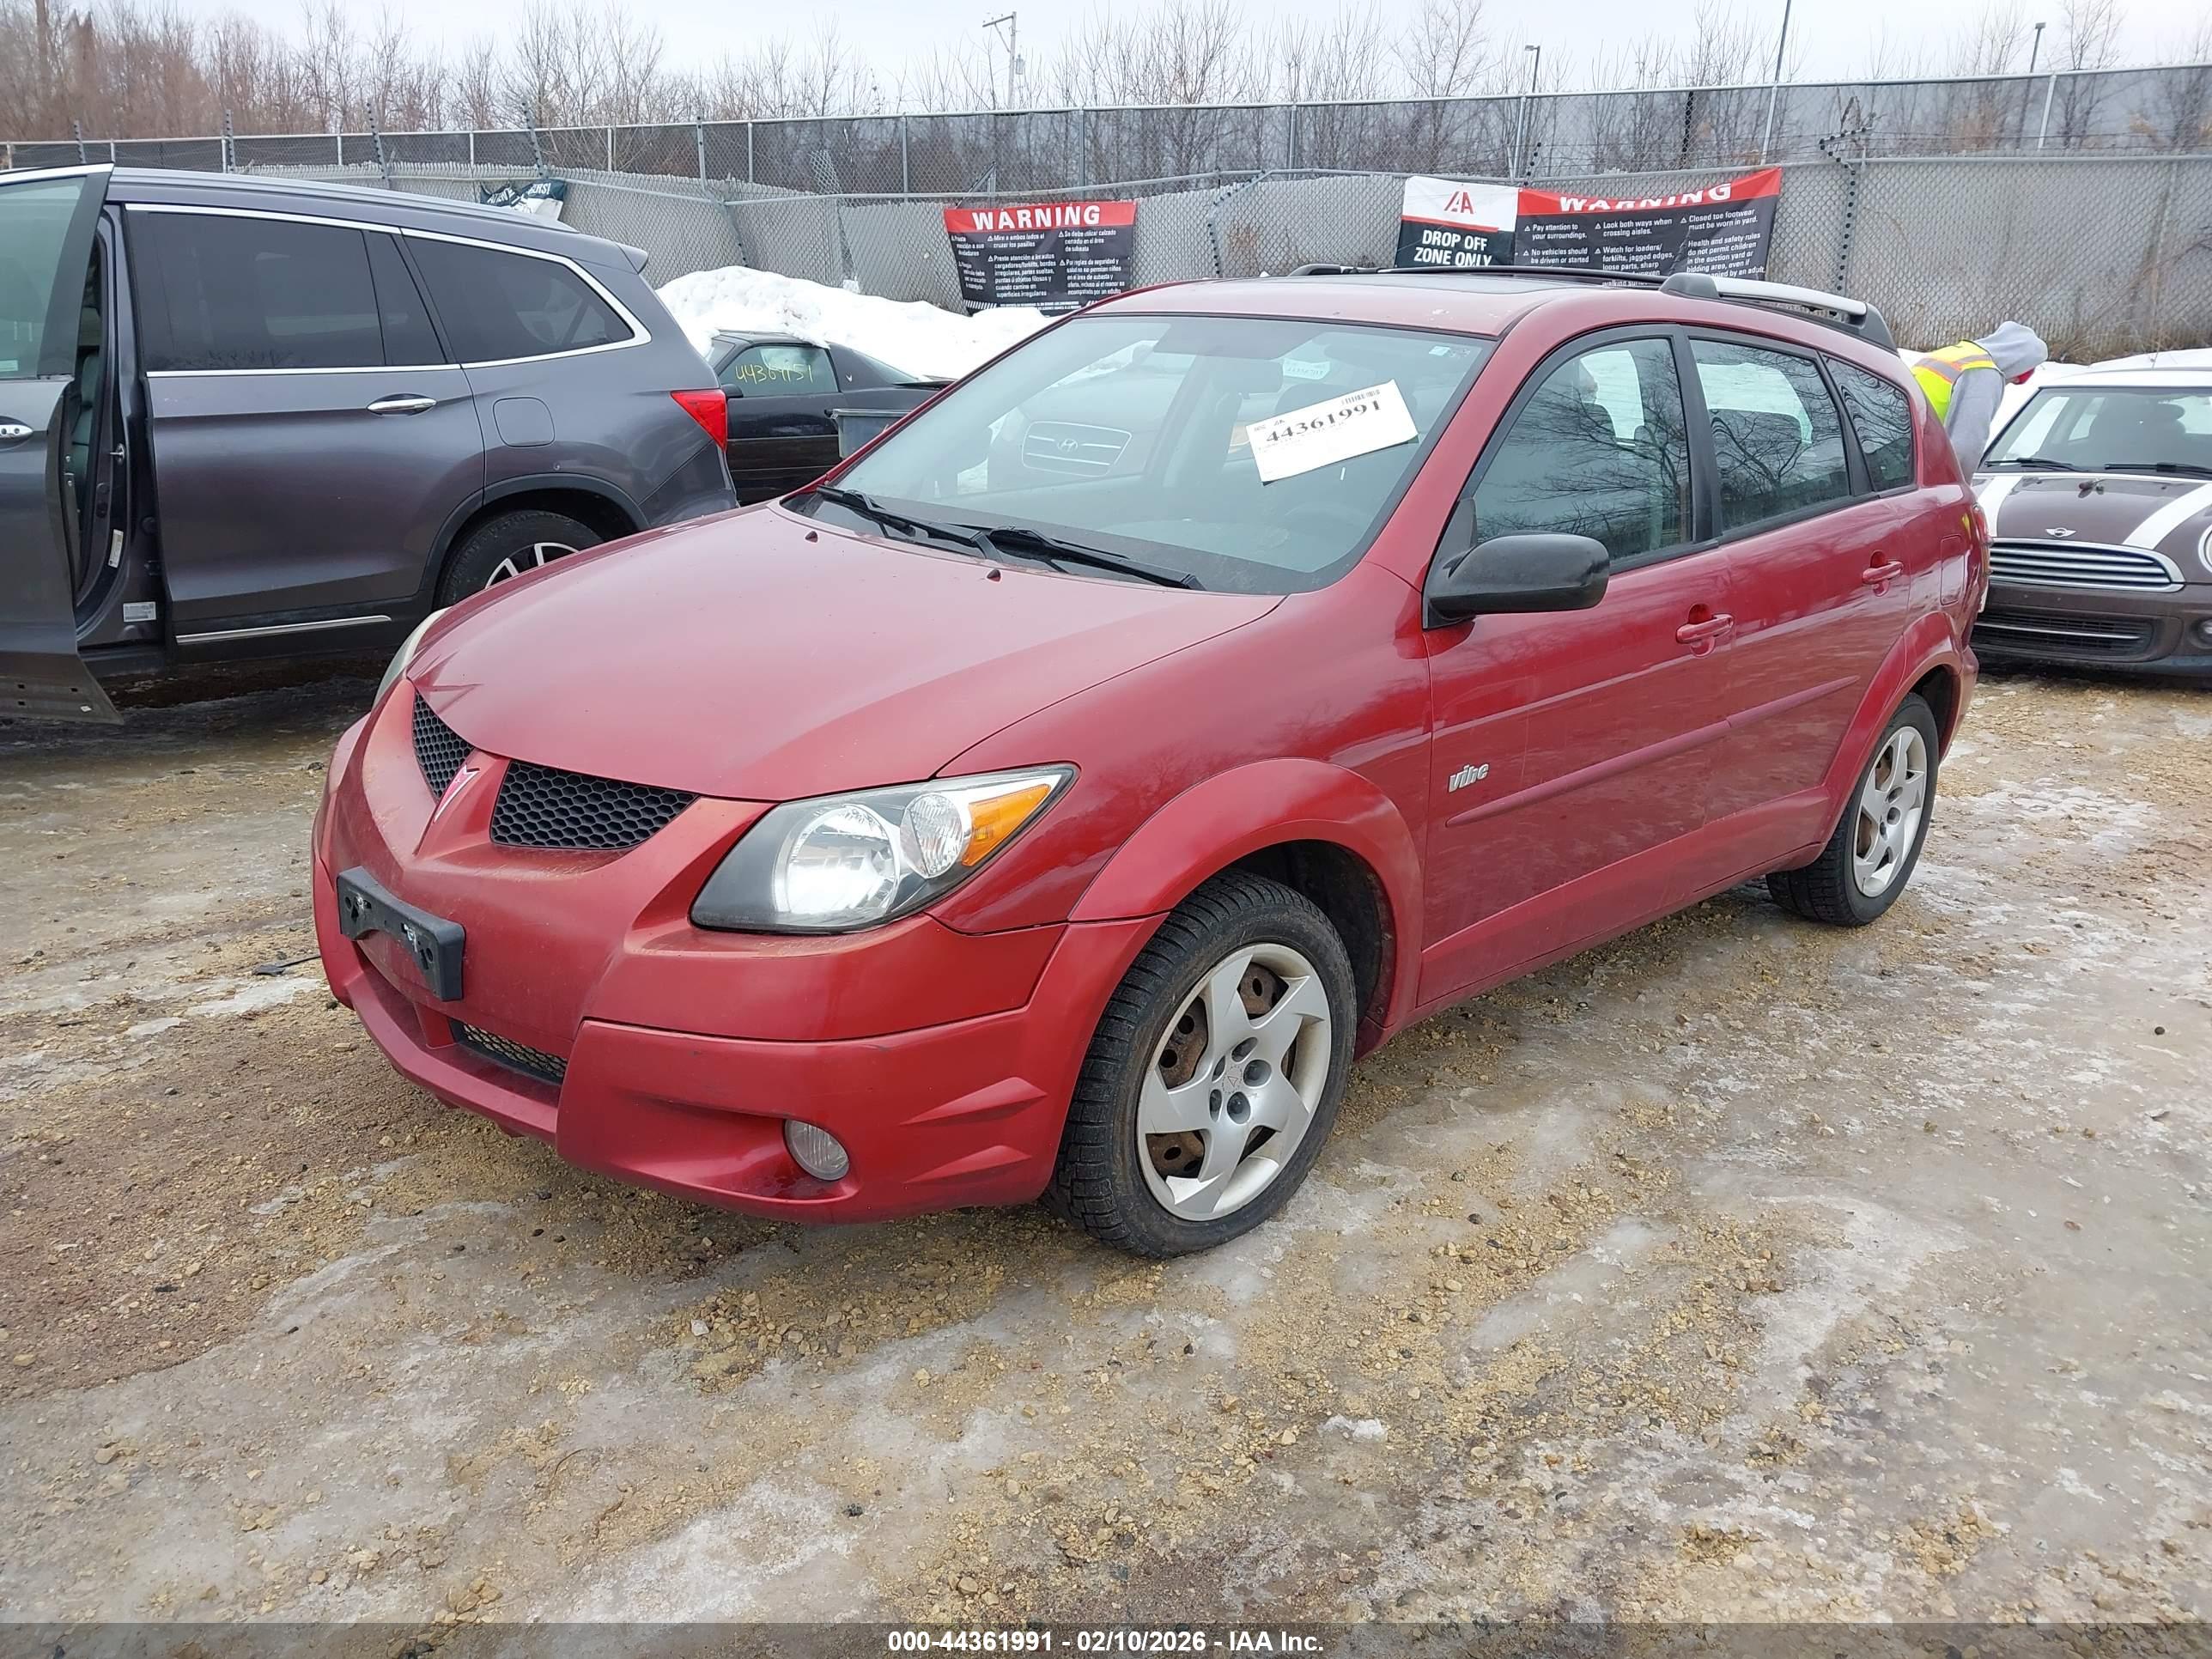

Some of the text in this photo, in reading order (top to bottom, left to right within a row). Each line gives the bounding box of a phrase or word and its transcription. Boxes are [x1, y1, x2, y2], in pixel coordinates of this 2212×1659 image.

[972, 205, 1100, 230] WARNING
[1689, 214, 1711, 222] Closed
[1725, 209, 1755, 218] footwear
[1742, 216, 1758, 225] yard.
[1533, 224, 1544, 233] Pay
[1422, 229, 1487, 251] DROP OFF
[1688, 239, 1709, 247] Health
[1724, 235, 1744, 244] safety
[1709, 246, 1729, 255] permit
[1730, 241, 1756, 251] children
[1413, 246, 1492, 267] ZONE ONLY
[1629, 253, 1650, 262] jagged
[1706, 253, 1729, 263] auction
[1731, 251, 1745, 260] yard
[1686, 264, 1709, 273] bidding
[1267, 400, 1381, 441] 44361991
